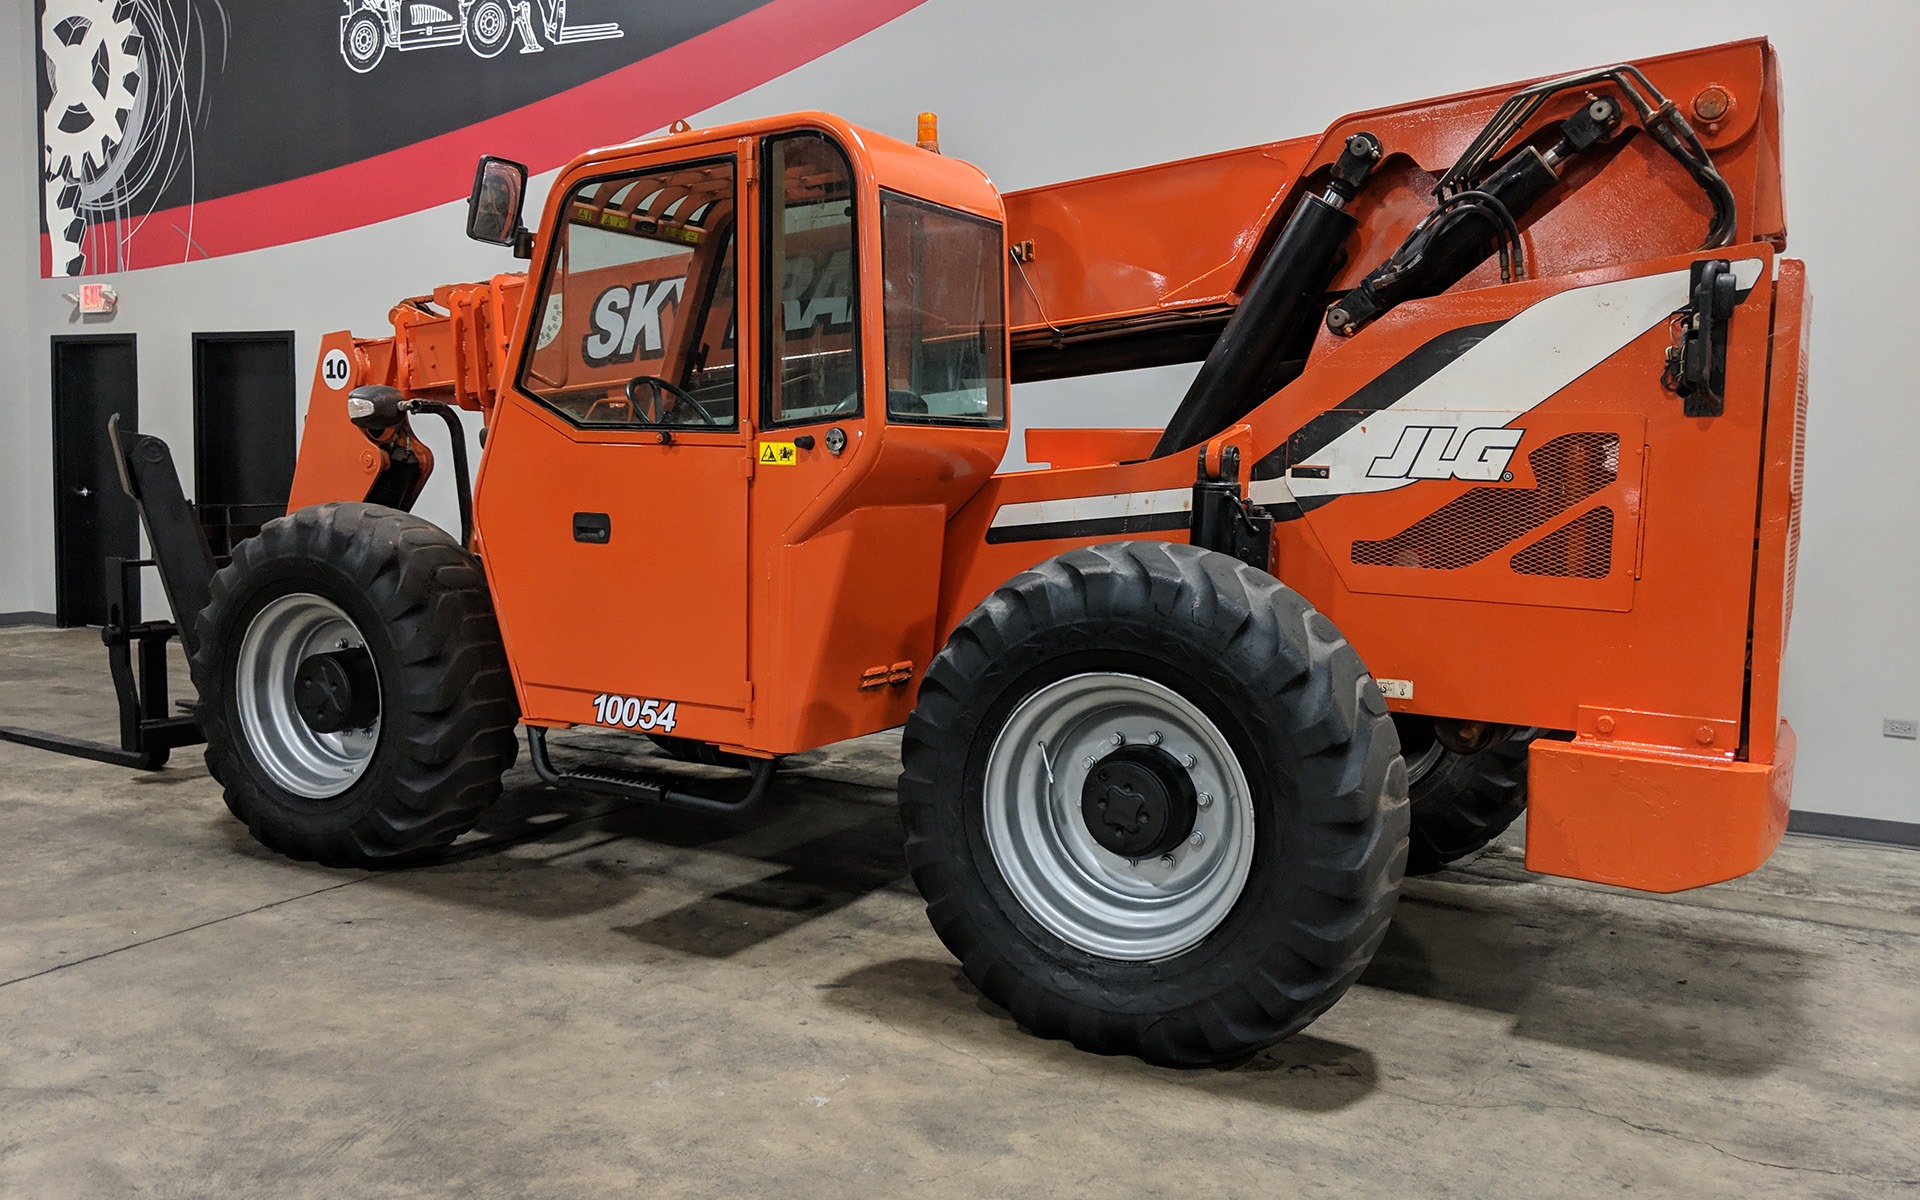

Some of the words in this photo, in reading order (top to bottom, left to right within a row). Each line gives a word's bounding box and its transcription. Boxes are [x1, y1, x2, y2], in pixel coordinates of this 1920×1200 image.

[83, 285, 103, 309] EXIT
[326, 358, 348, 379] 10
[1365, 425, 1527, 482] JLG
[593, 693, 677, 732] 10054
